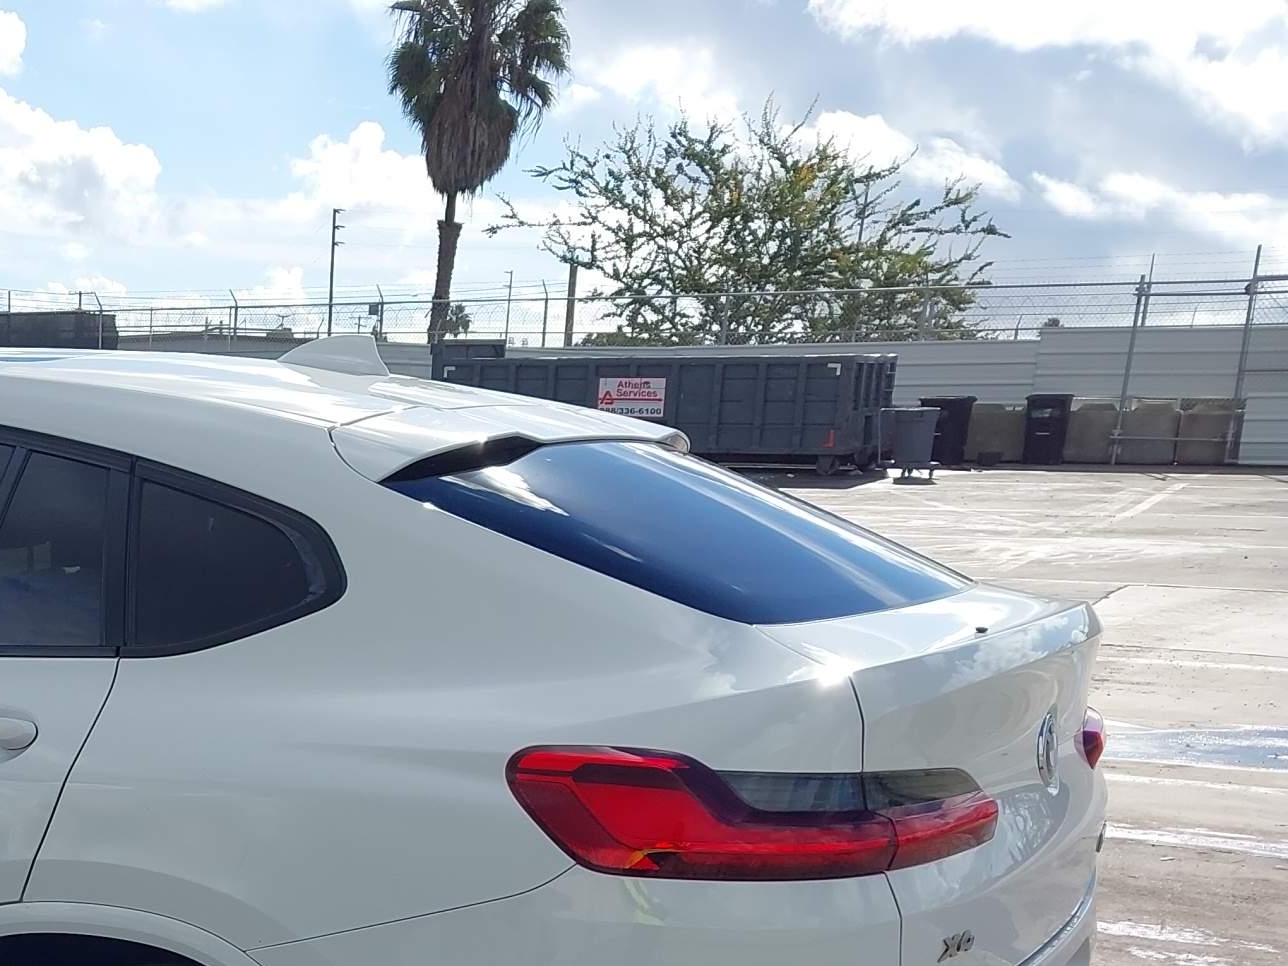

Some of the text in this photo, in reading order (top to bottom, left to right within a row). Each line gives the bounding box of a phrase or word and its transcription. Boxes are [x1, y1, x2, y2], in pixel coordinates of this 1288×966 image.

[617, 380, 651, 390] Athens
[616, 389, 658, 398] Services
[937, 929, 975, 963] X4
